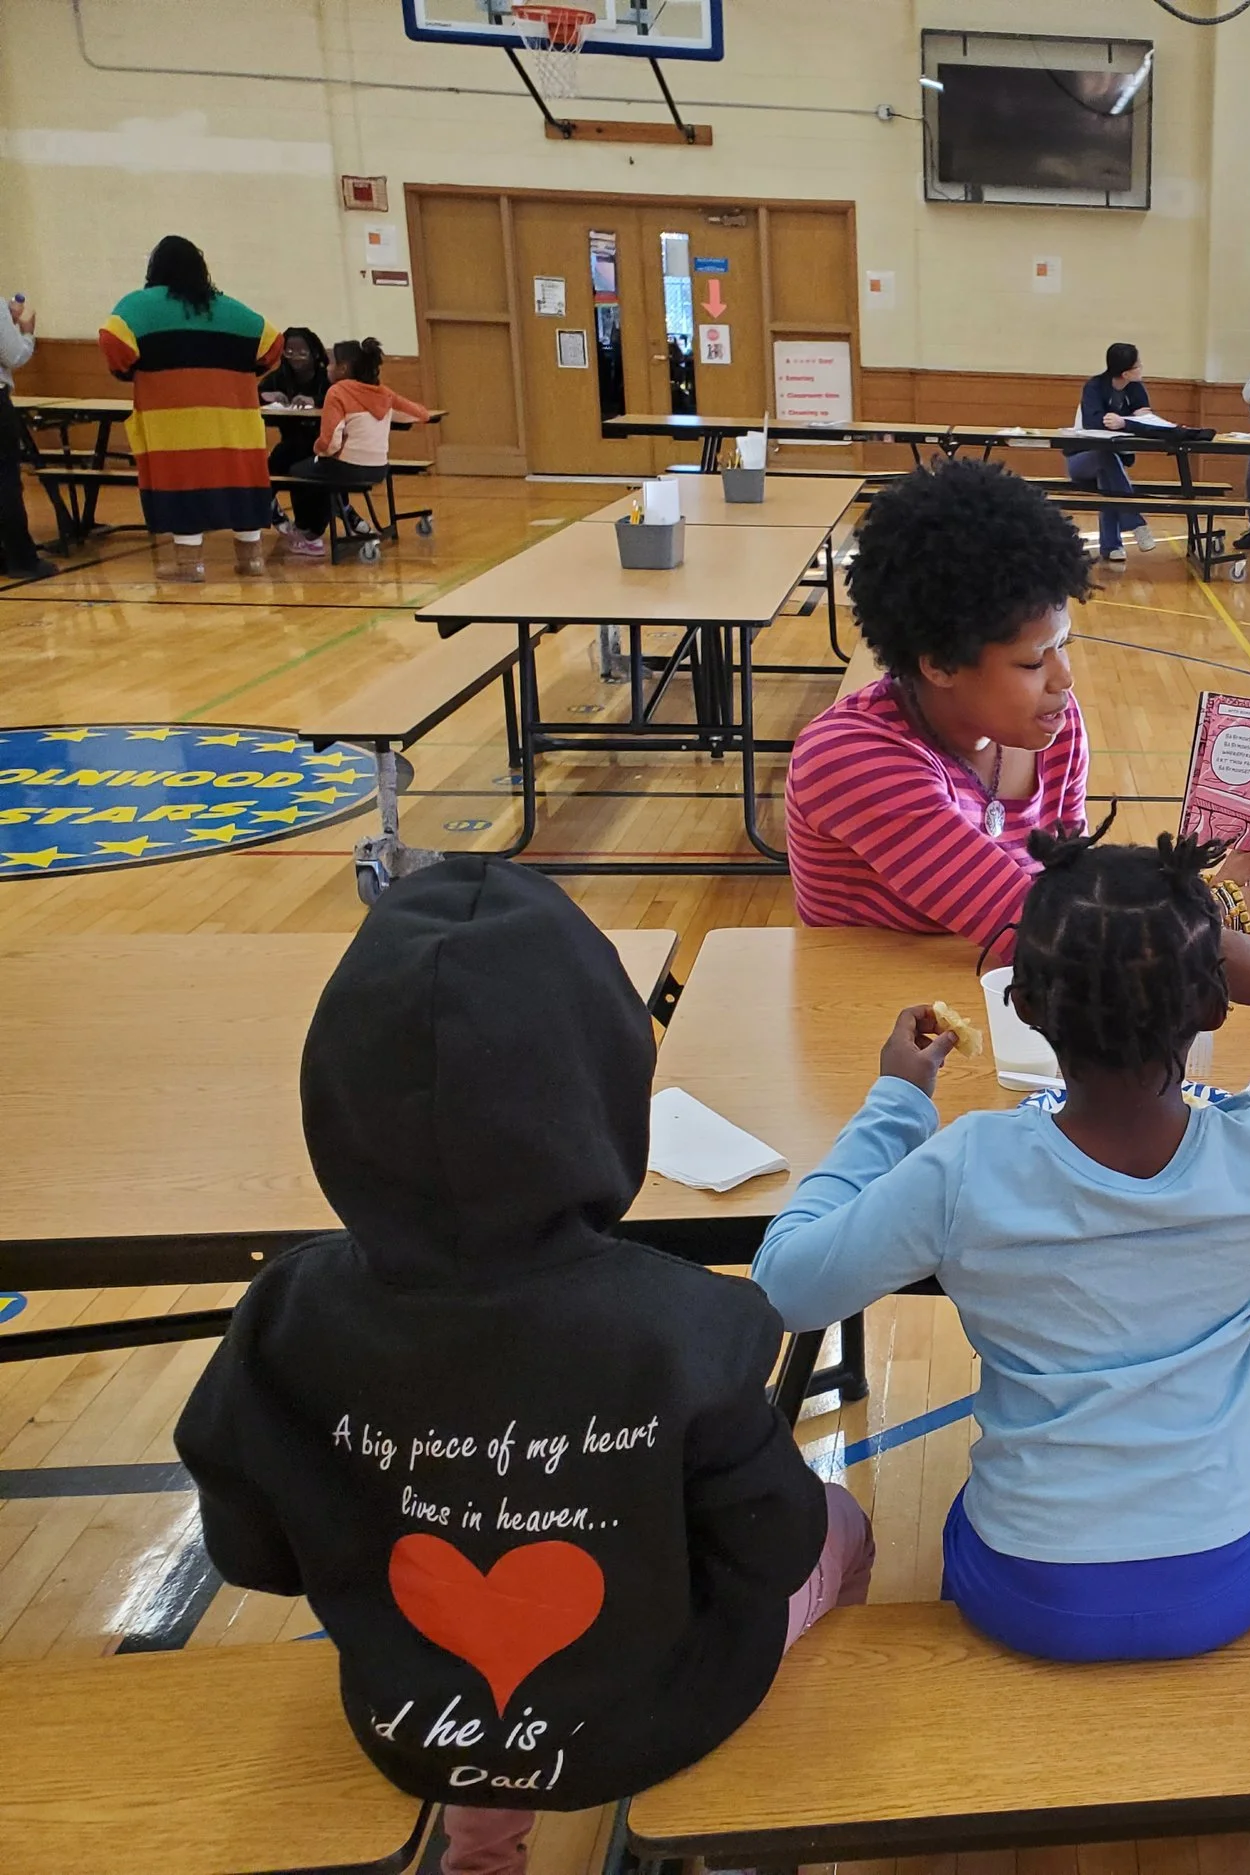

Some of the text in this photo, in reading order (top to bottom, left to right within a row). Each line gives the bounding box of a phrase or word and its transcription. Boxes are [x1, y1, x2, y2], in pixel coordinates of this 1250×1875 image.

[0, 801, 259, 825] STARS
[332, 1413, 659, 1477] A big piece of my heart
[401, 1485, 619, 1532] lives in heaven...
[423, 1694, 485, 1749] he
[505, 1706, 548, 1751] is
[449, 1748, 564, 1790] Dad!
